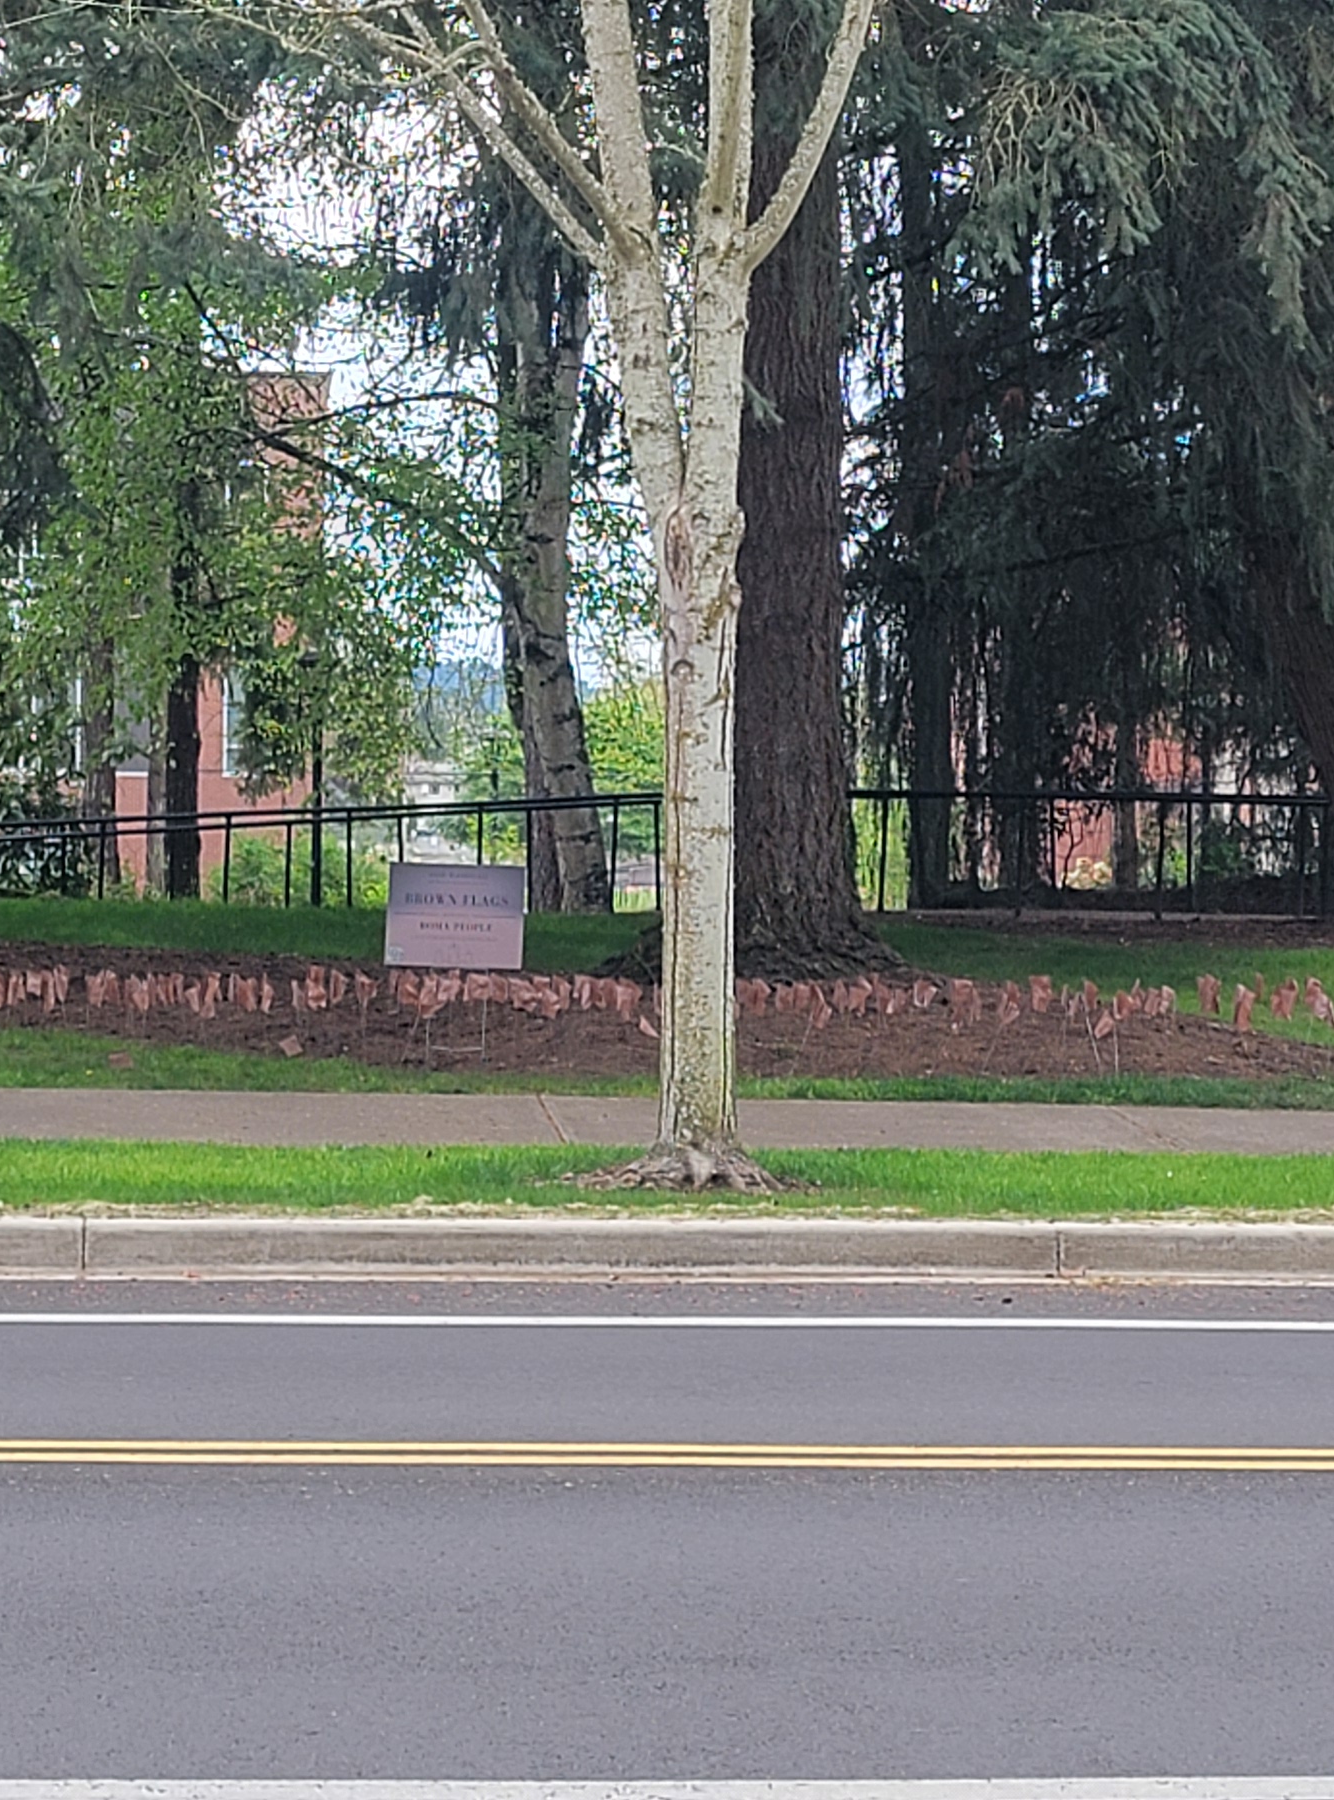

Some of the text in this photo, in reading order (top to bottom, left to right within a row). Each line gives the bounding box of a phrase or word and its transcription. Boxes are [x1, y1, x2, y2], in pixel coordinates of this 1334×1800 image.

[405, 893, 509, 906] BROWN FLAGS
[420, 921, 492, 932] ROMA PEOPLE
